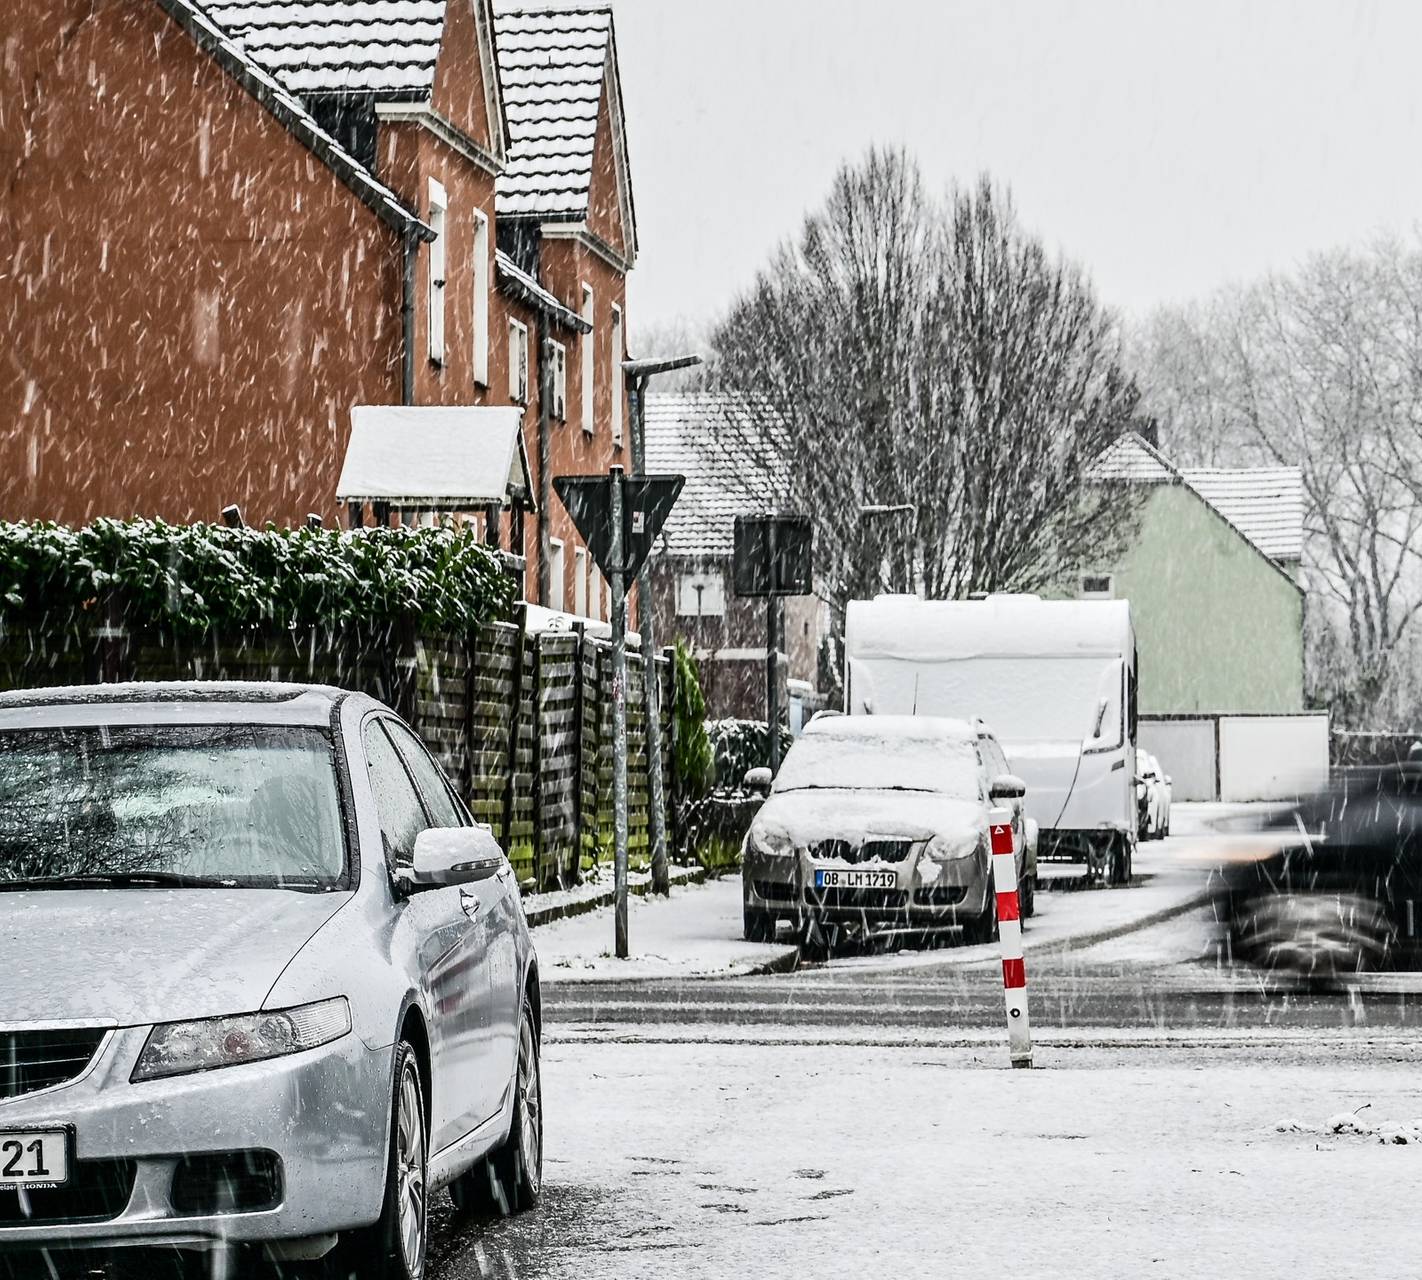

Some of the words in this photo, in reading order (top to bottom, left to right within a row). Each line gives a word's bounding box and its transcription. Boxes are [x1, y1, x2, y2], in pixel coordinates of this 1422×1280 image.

[824, 872, 839, 886] OB
[847, 873, 863, 886] LM
[865, 873, 894, 887] 1719
[2, 1139, 50, 1177] 21
